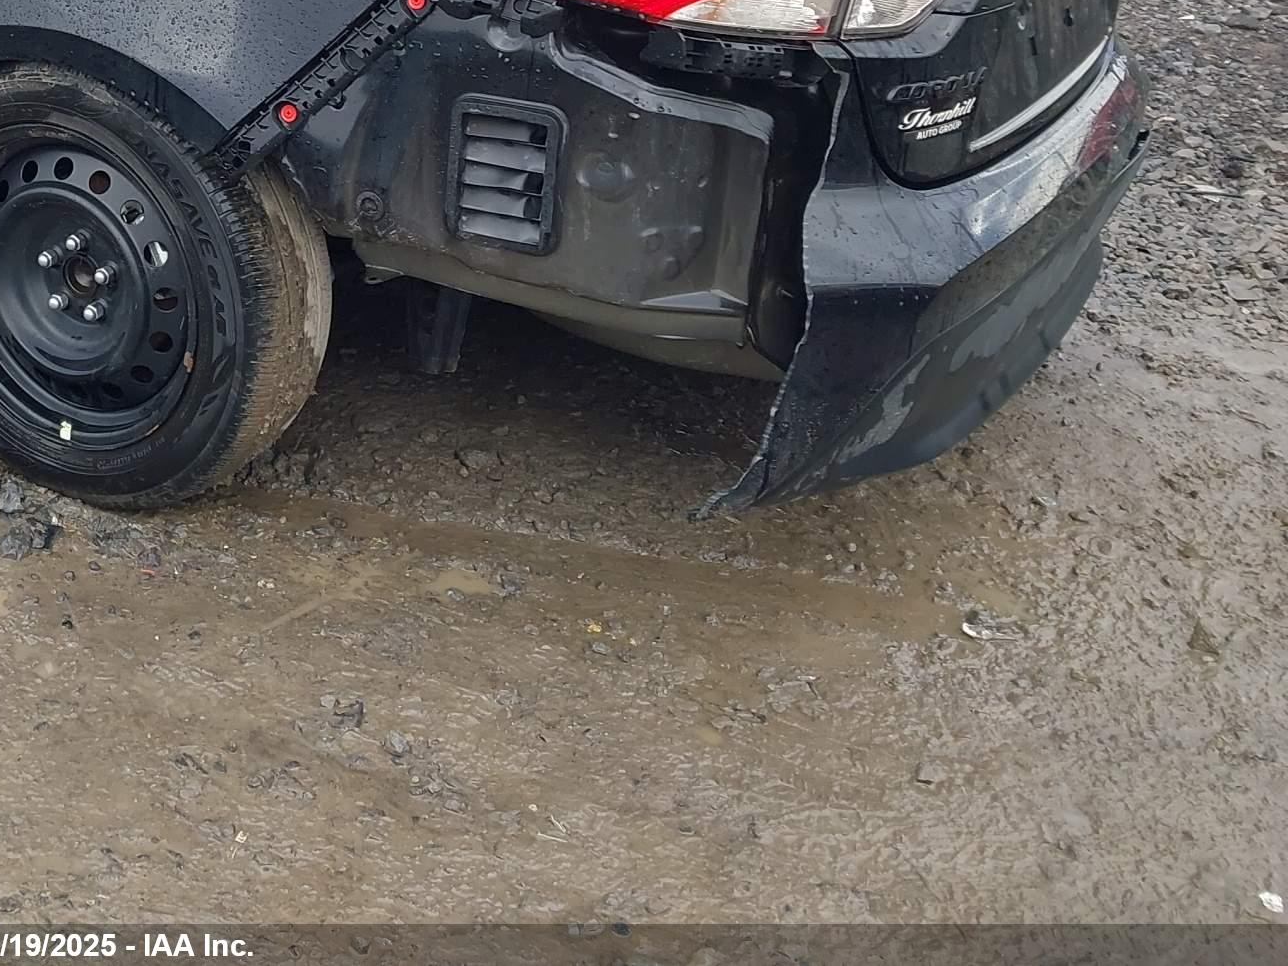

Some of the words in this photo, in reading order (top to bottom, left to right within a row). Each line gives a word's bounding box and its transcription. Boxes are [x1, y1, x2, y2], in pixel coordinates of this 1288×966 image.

[897, 97, 977, 130] Thornhill
[916, 128, 938, 140] AUTO
[938, 120, 963, 134] GROUP
